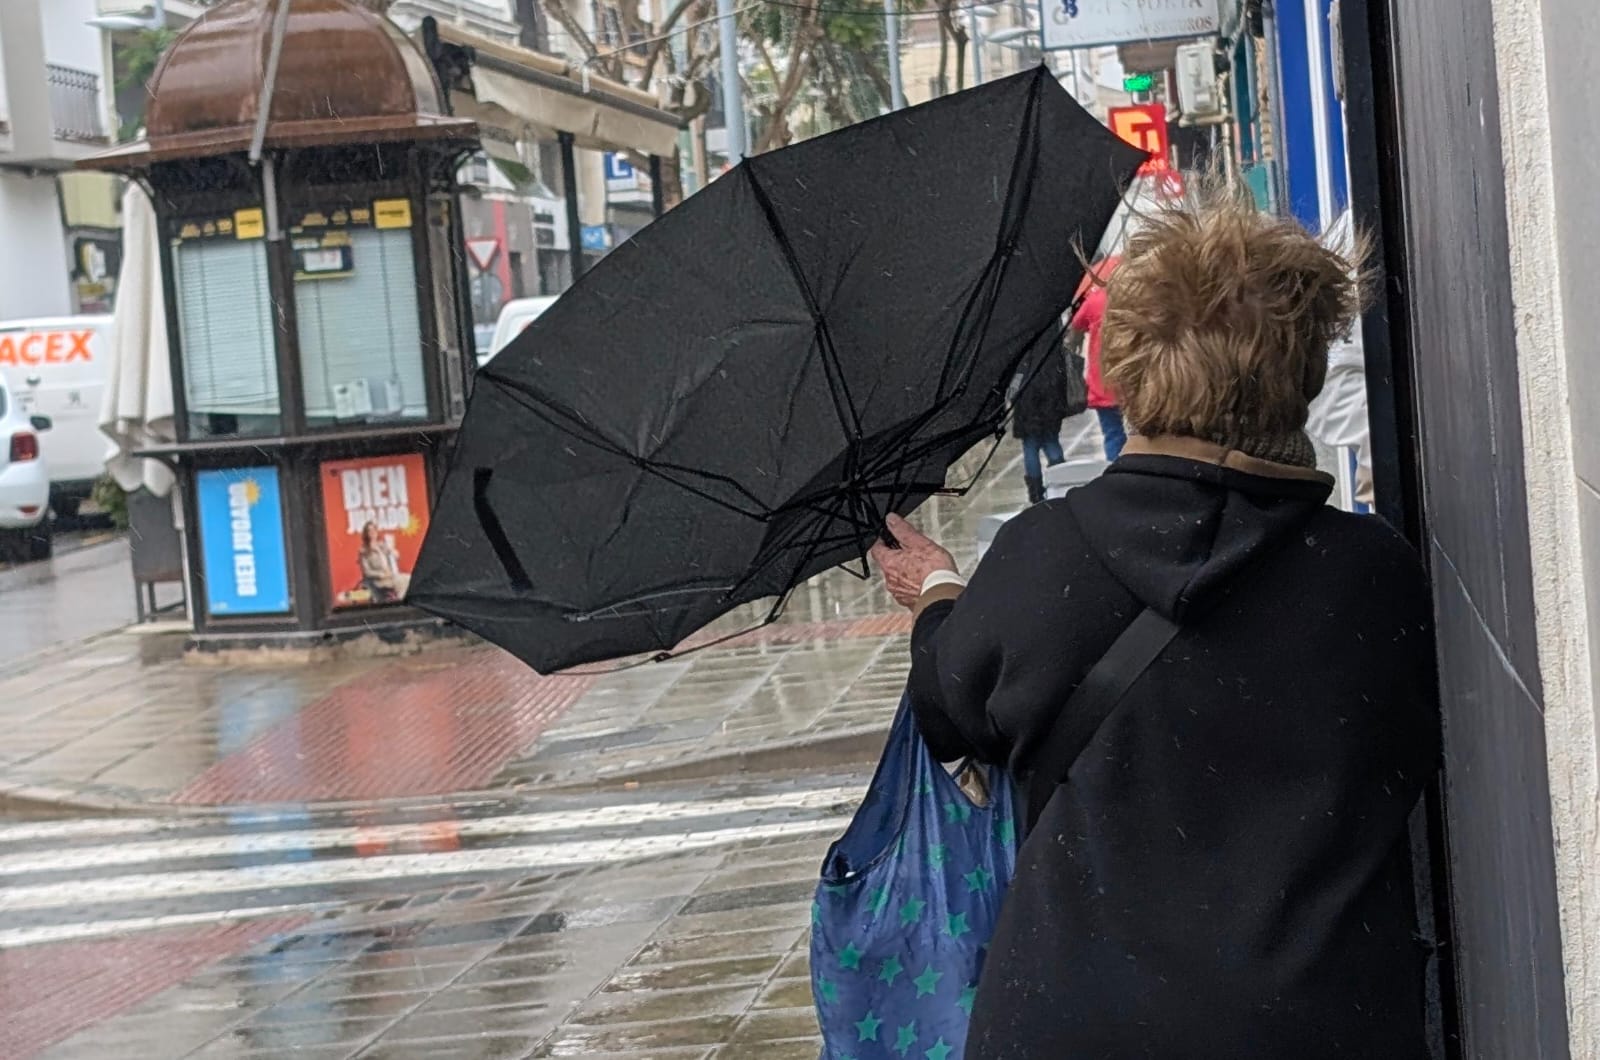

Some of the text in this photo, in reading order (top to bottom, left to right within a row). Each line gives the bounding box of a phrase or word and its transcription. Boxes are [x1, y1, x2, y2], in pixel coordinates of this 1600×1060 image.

[0, 329, 94, 366] ACEX
[342, 466, 407, 509] BIEN
[235, 553, 257, 596] BIEN
